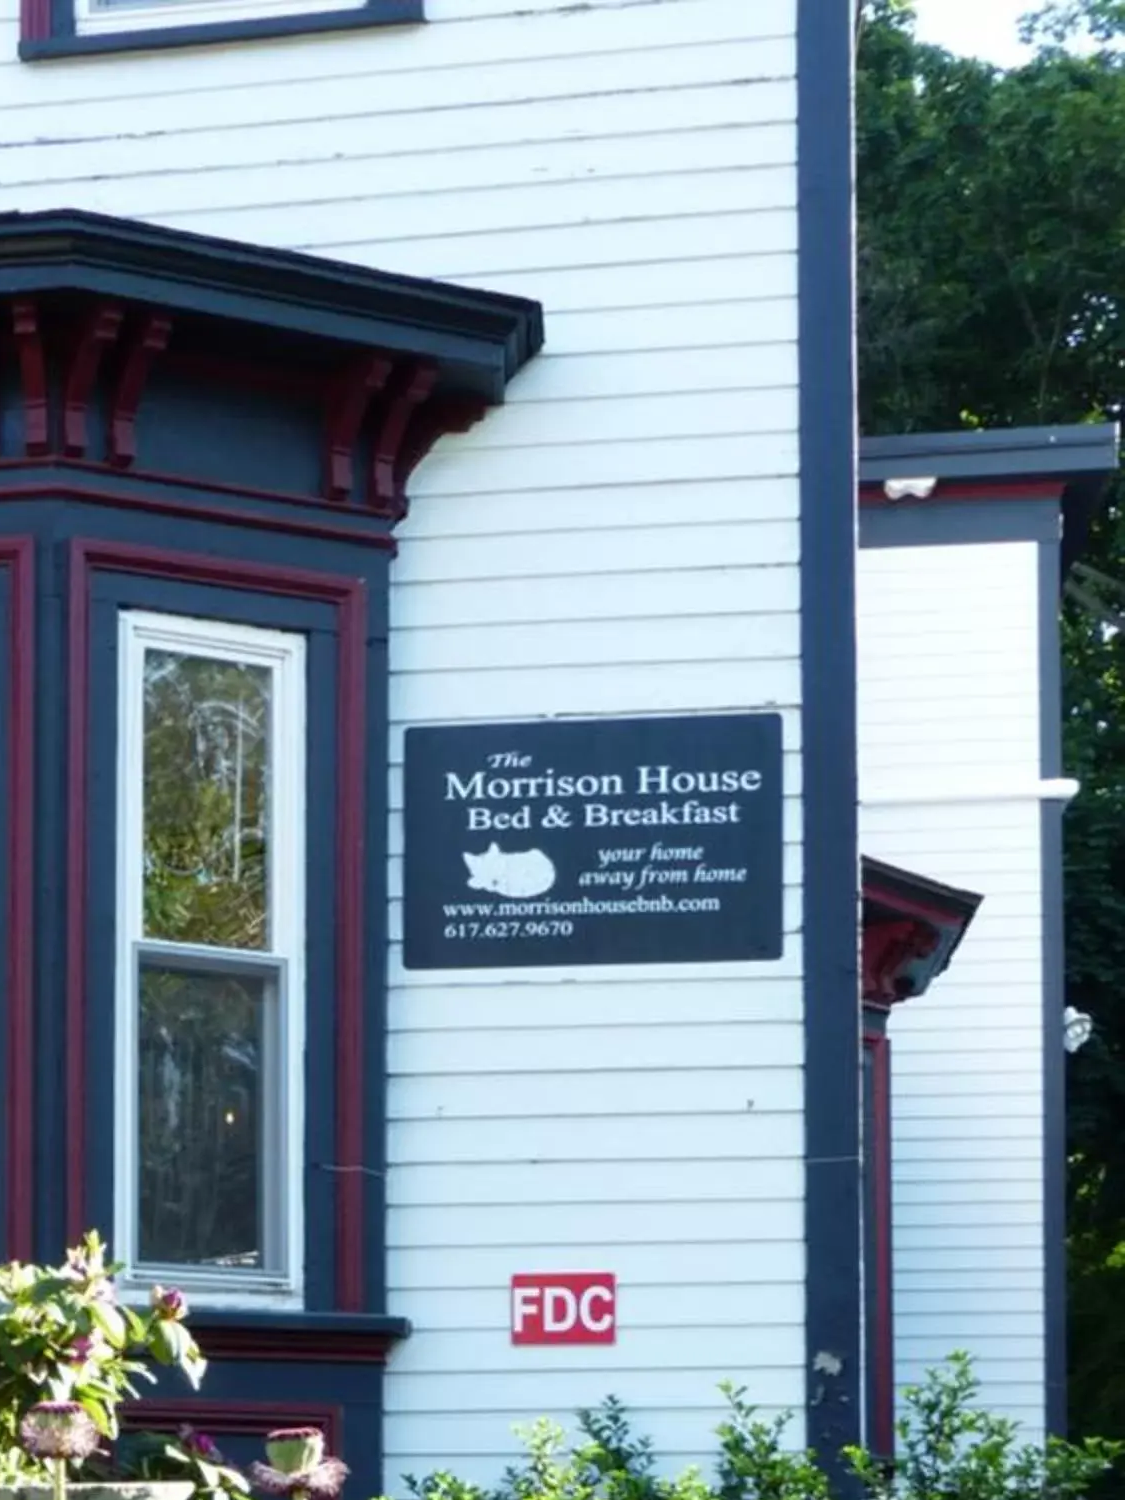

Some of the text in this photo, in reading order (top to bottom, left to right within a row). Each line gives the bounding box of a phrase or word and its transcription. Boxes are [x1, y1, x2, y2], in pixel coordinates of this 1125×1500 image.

[487, 751, 532, 768] The
[444, 765, 763, 800] Morrison House
[467, 801, 742, 831] Bed & Breakfast
[598, 841, 705, 868] your home
[578, 862, 748, 891] away from home
[442, 894, 721, 918] www.morrisonhousebnb.com
[443, 919, 574, 939] 617.627.9670
[513, 1285, 614, 1333] FDC
